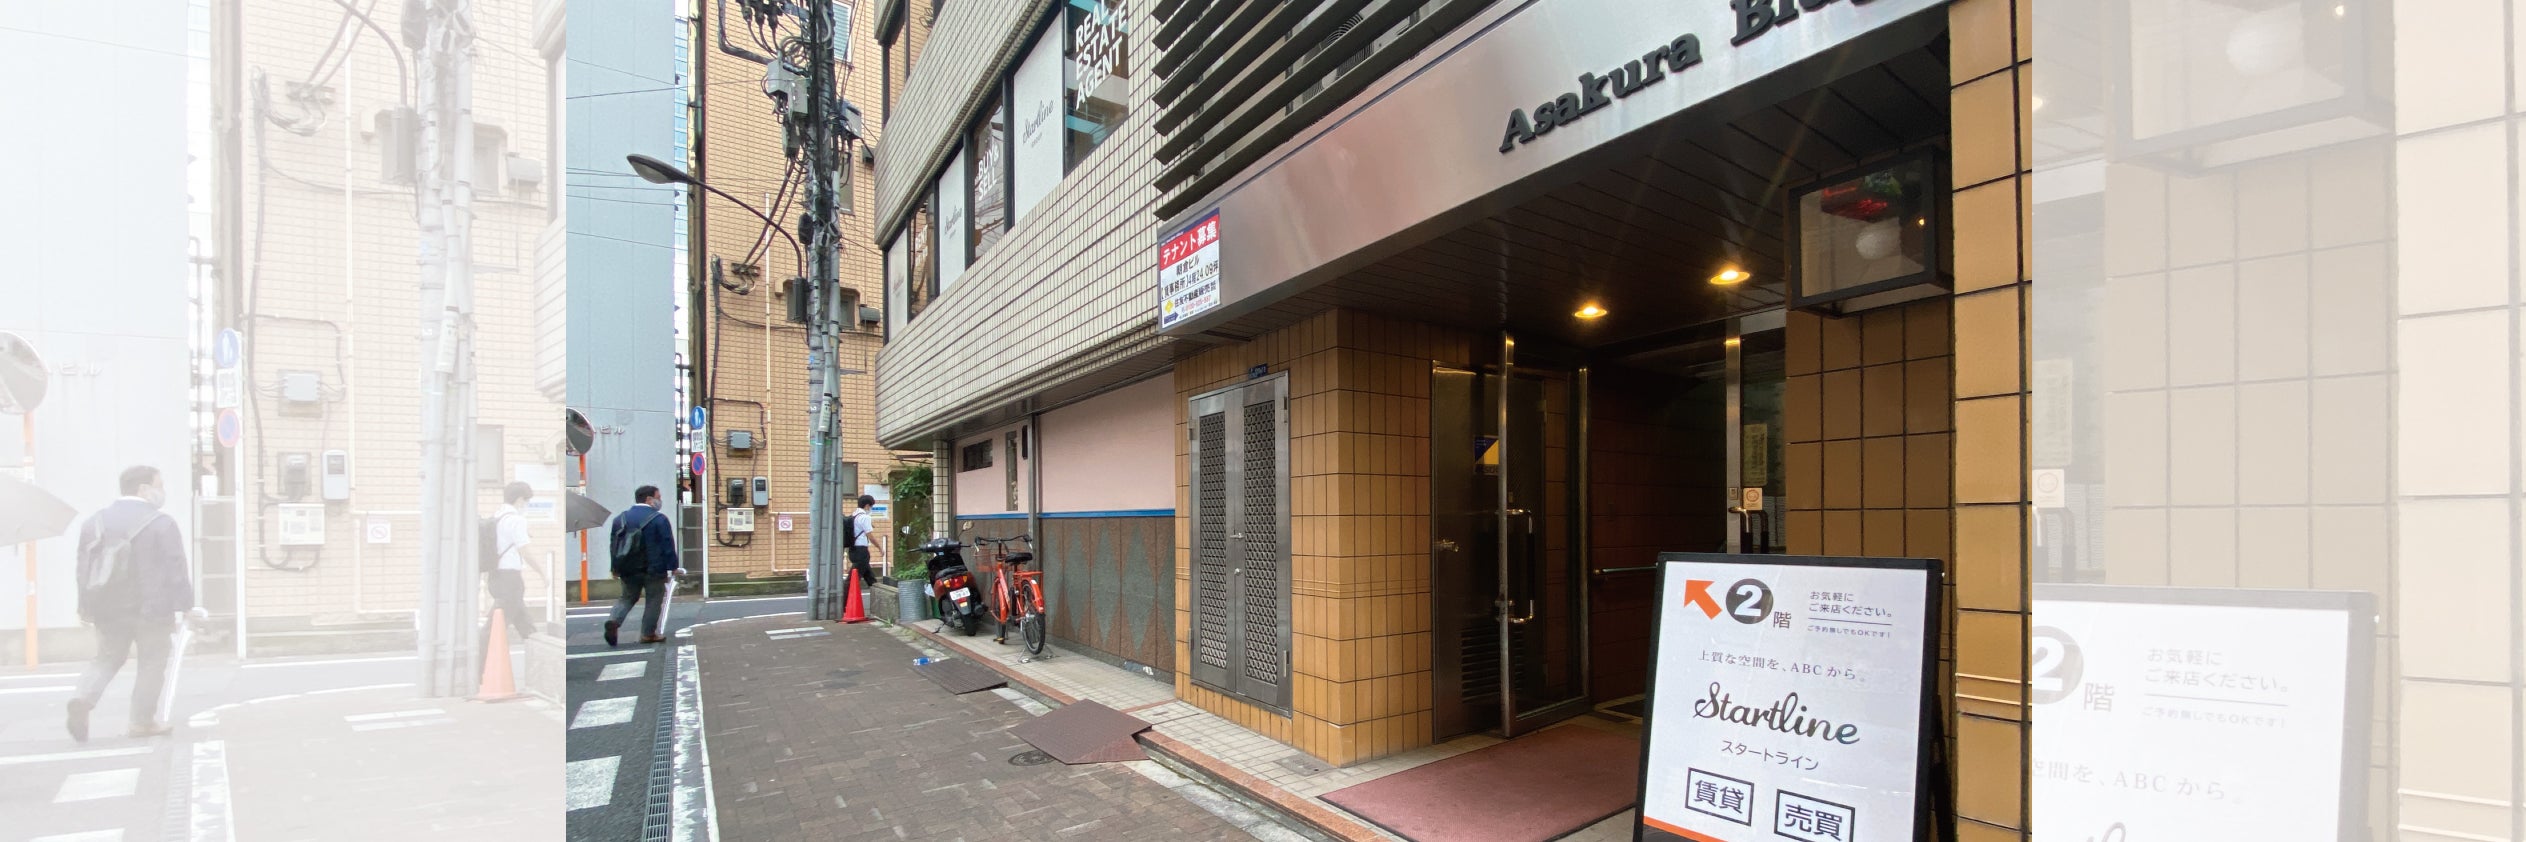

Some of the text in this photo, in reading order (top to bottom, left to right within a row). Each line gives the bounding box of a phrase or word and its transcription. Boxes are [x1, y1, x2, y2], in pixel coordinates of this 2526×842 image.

[1075, 0, 1109, 53] REAL
[1076, 0, 1128, 81] ESTATE
[1076, 35, 1123, 111] AGENT
[1500, 32, 1703, 153] Asakura
[978, 166, 998, 201] SELL
[1163, 220, 1217, 265] テナント募集
[1809, 603, 1892, 618] ご来店ください。
[1810, 591, 1854, 602] お気軽に
[2147, 648, 2224, 667] お気軽に
[2145, 668, 2289, 693] ご来店ください。
[1693, 681, 1861, 745] Startline
[1721, 740, 1820, 771] スタートライン
[1694, 779, 1843, 842] 賃貸 売買
